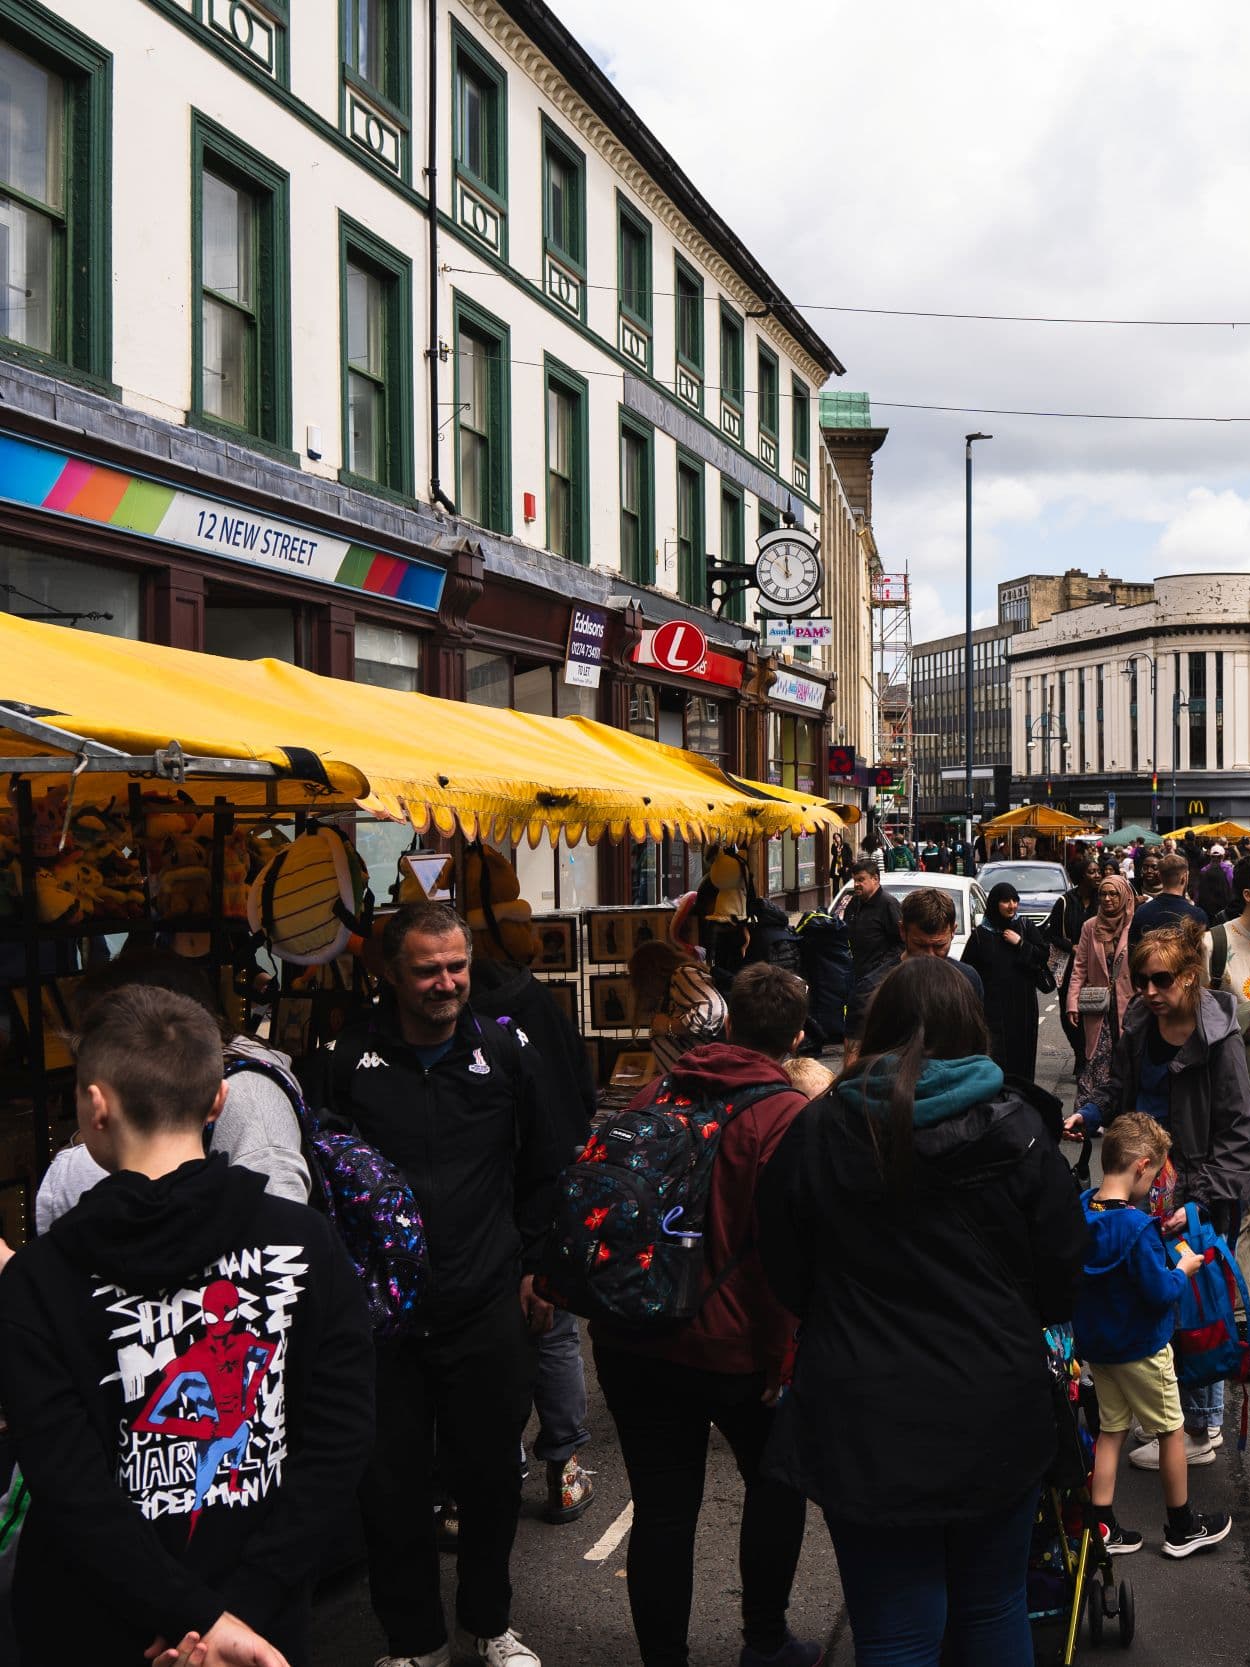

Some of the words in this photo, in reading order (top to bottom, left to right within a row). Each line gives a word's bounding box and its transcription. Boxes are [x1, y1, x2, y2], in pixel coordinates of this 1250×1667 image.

[196, 511, 217, 540] 12
[219, 517, 260, 550] NEW
[261, 529, 317, 565] STREET
[574, 611, 604, 638] Eddisons
